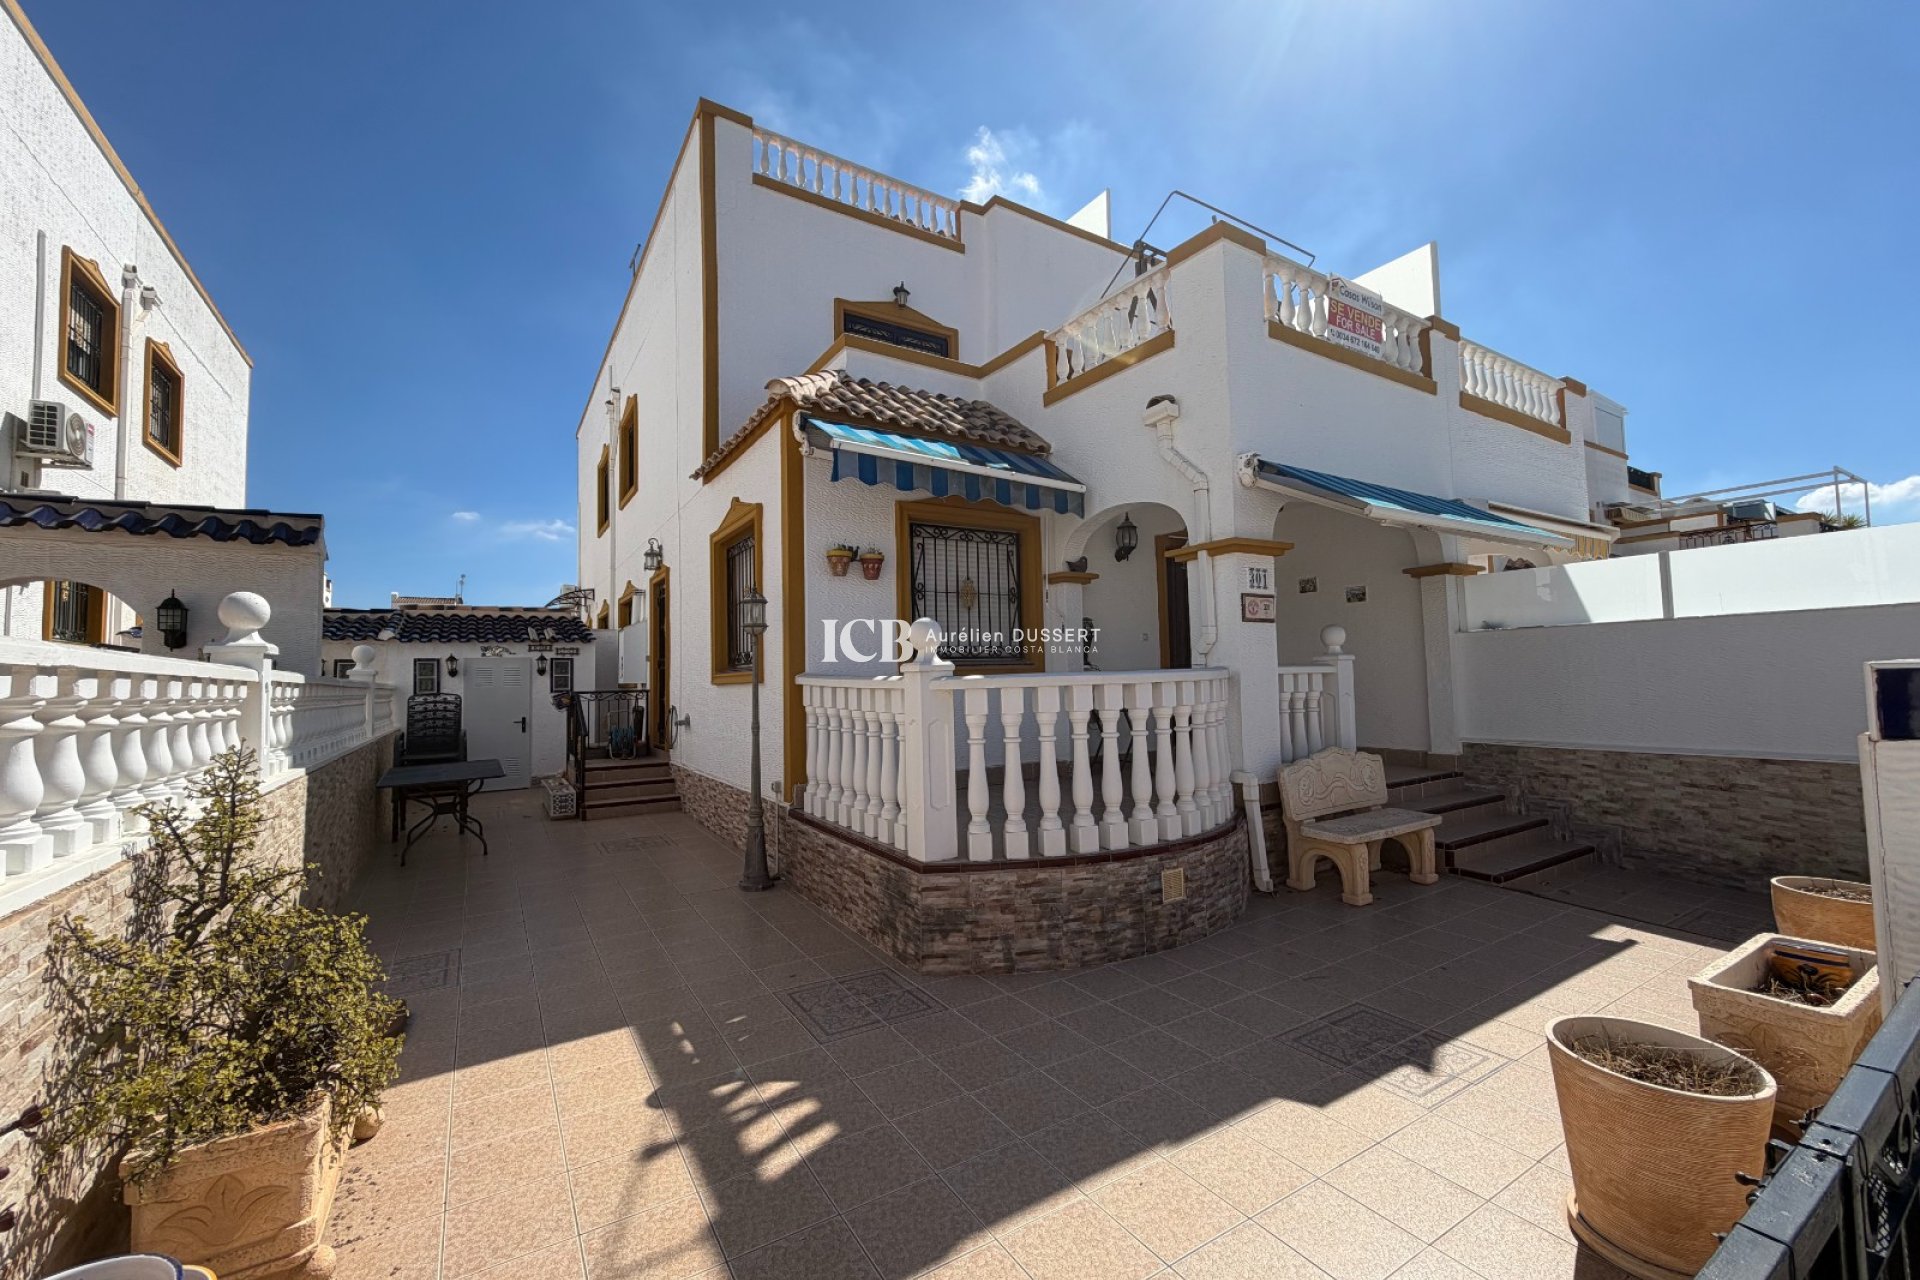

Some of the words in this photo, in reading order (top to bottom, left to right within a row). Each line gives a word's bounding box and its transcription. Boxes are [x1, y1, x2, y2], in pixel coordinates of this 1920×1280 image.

[1330, 300, 1345, 316] SE
[1347, 306, 1381, 331] VENDE
[1336, 315, 1353, 331] FOR
[1355, 322, 1376, 339] SALE
